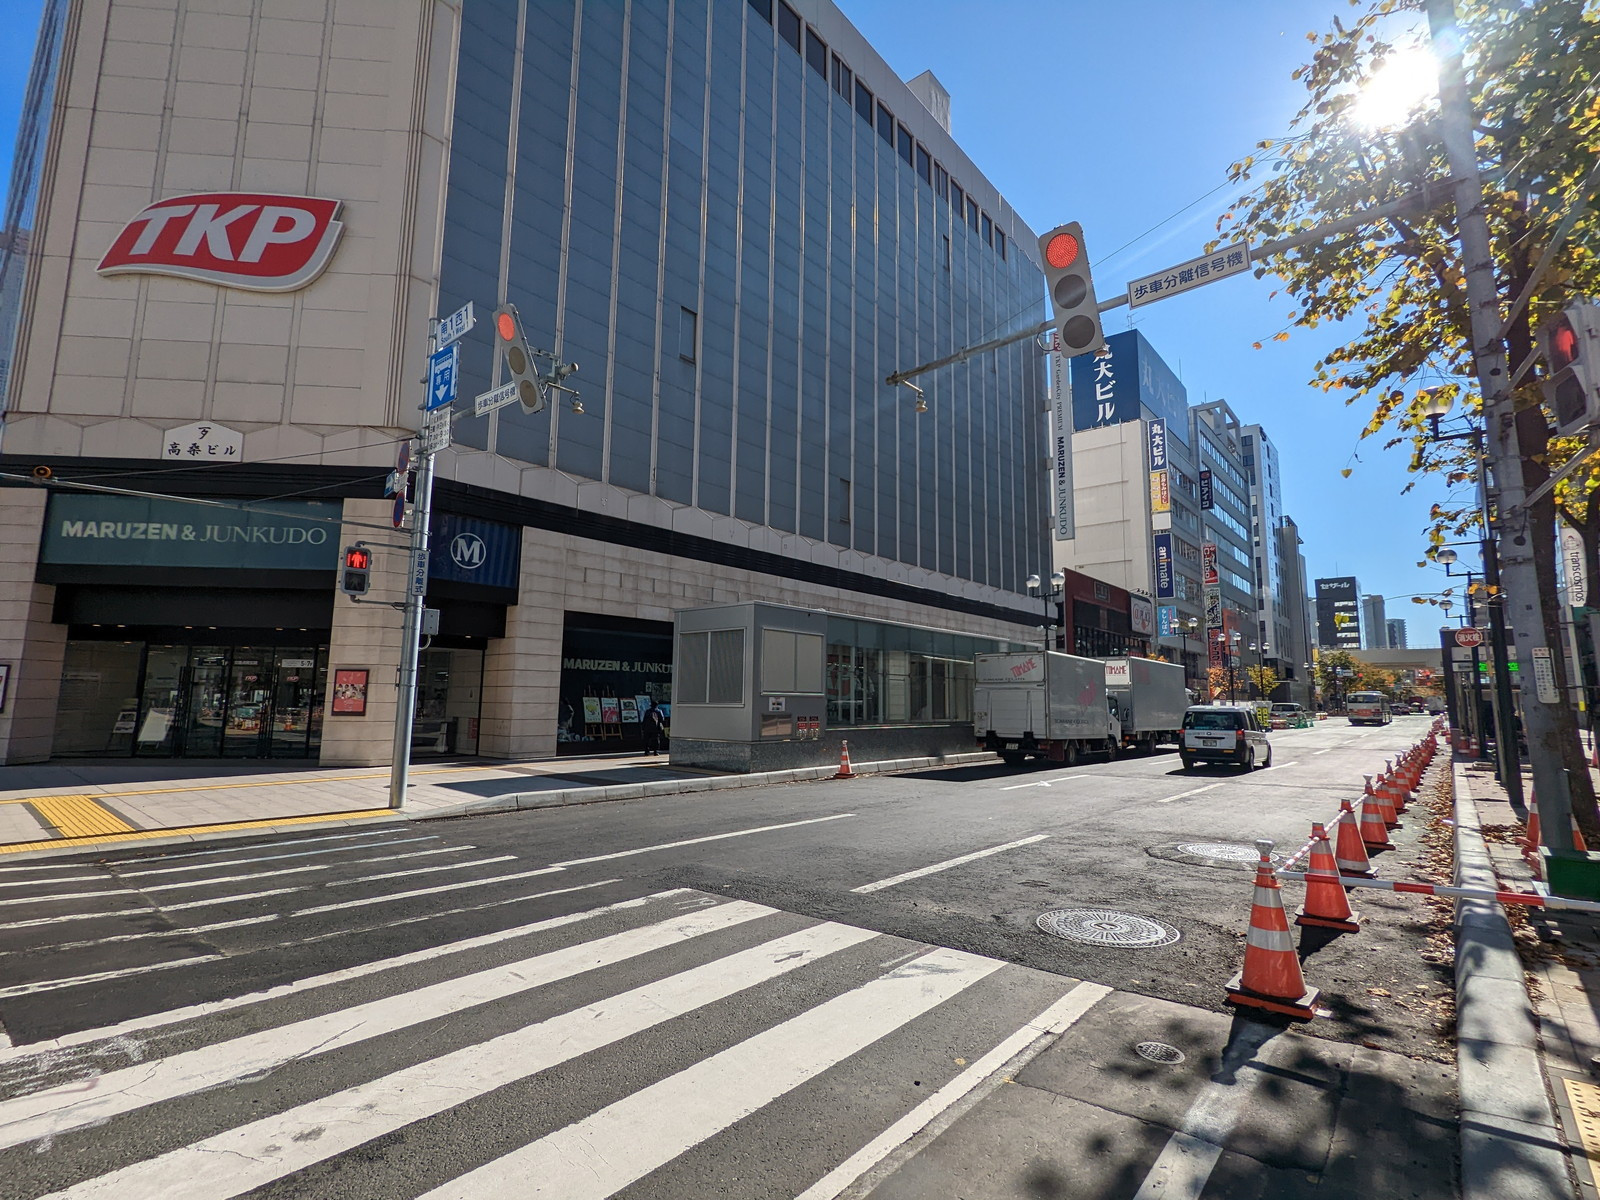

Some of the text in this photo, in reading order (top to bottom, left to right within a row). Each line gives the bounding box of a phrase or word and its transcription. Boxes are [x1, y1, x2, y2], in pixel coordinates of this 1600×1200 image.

[130, 203, 317, 263] TKP
[1134, 250, 1244, 300] 歩車分離信号機
[477, 386, 516, 410] 歩車分離信号機
[1057, 436, 1066, 479] MARUZEN
[1151, 423, 1165, 467] 丸大ビル
[1058, 486, 1068, 535] JUNKUDO
[61, 519, 328, 546] MARUZEN & JUNKUDO
[415, 552, 426, 594] 歩車分離式
[1159, 546, 1171, 589] animate
[1569, 551, 1585, 602] transcosmos
[1457, 633, 1481, 642] 消火栓
[563, 657, 673, 674] MARUZEN & JUNKU
